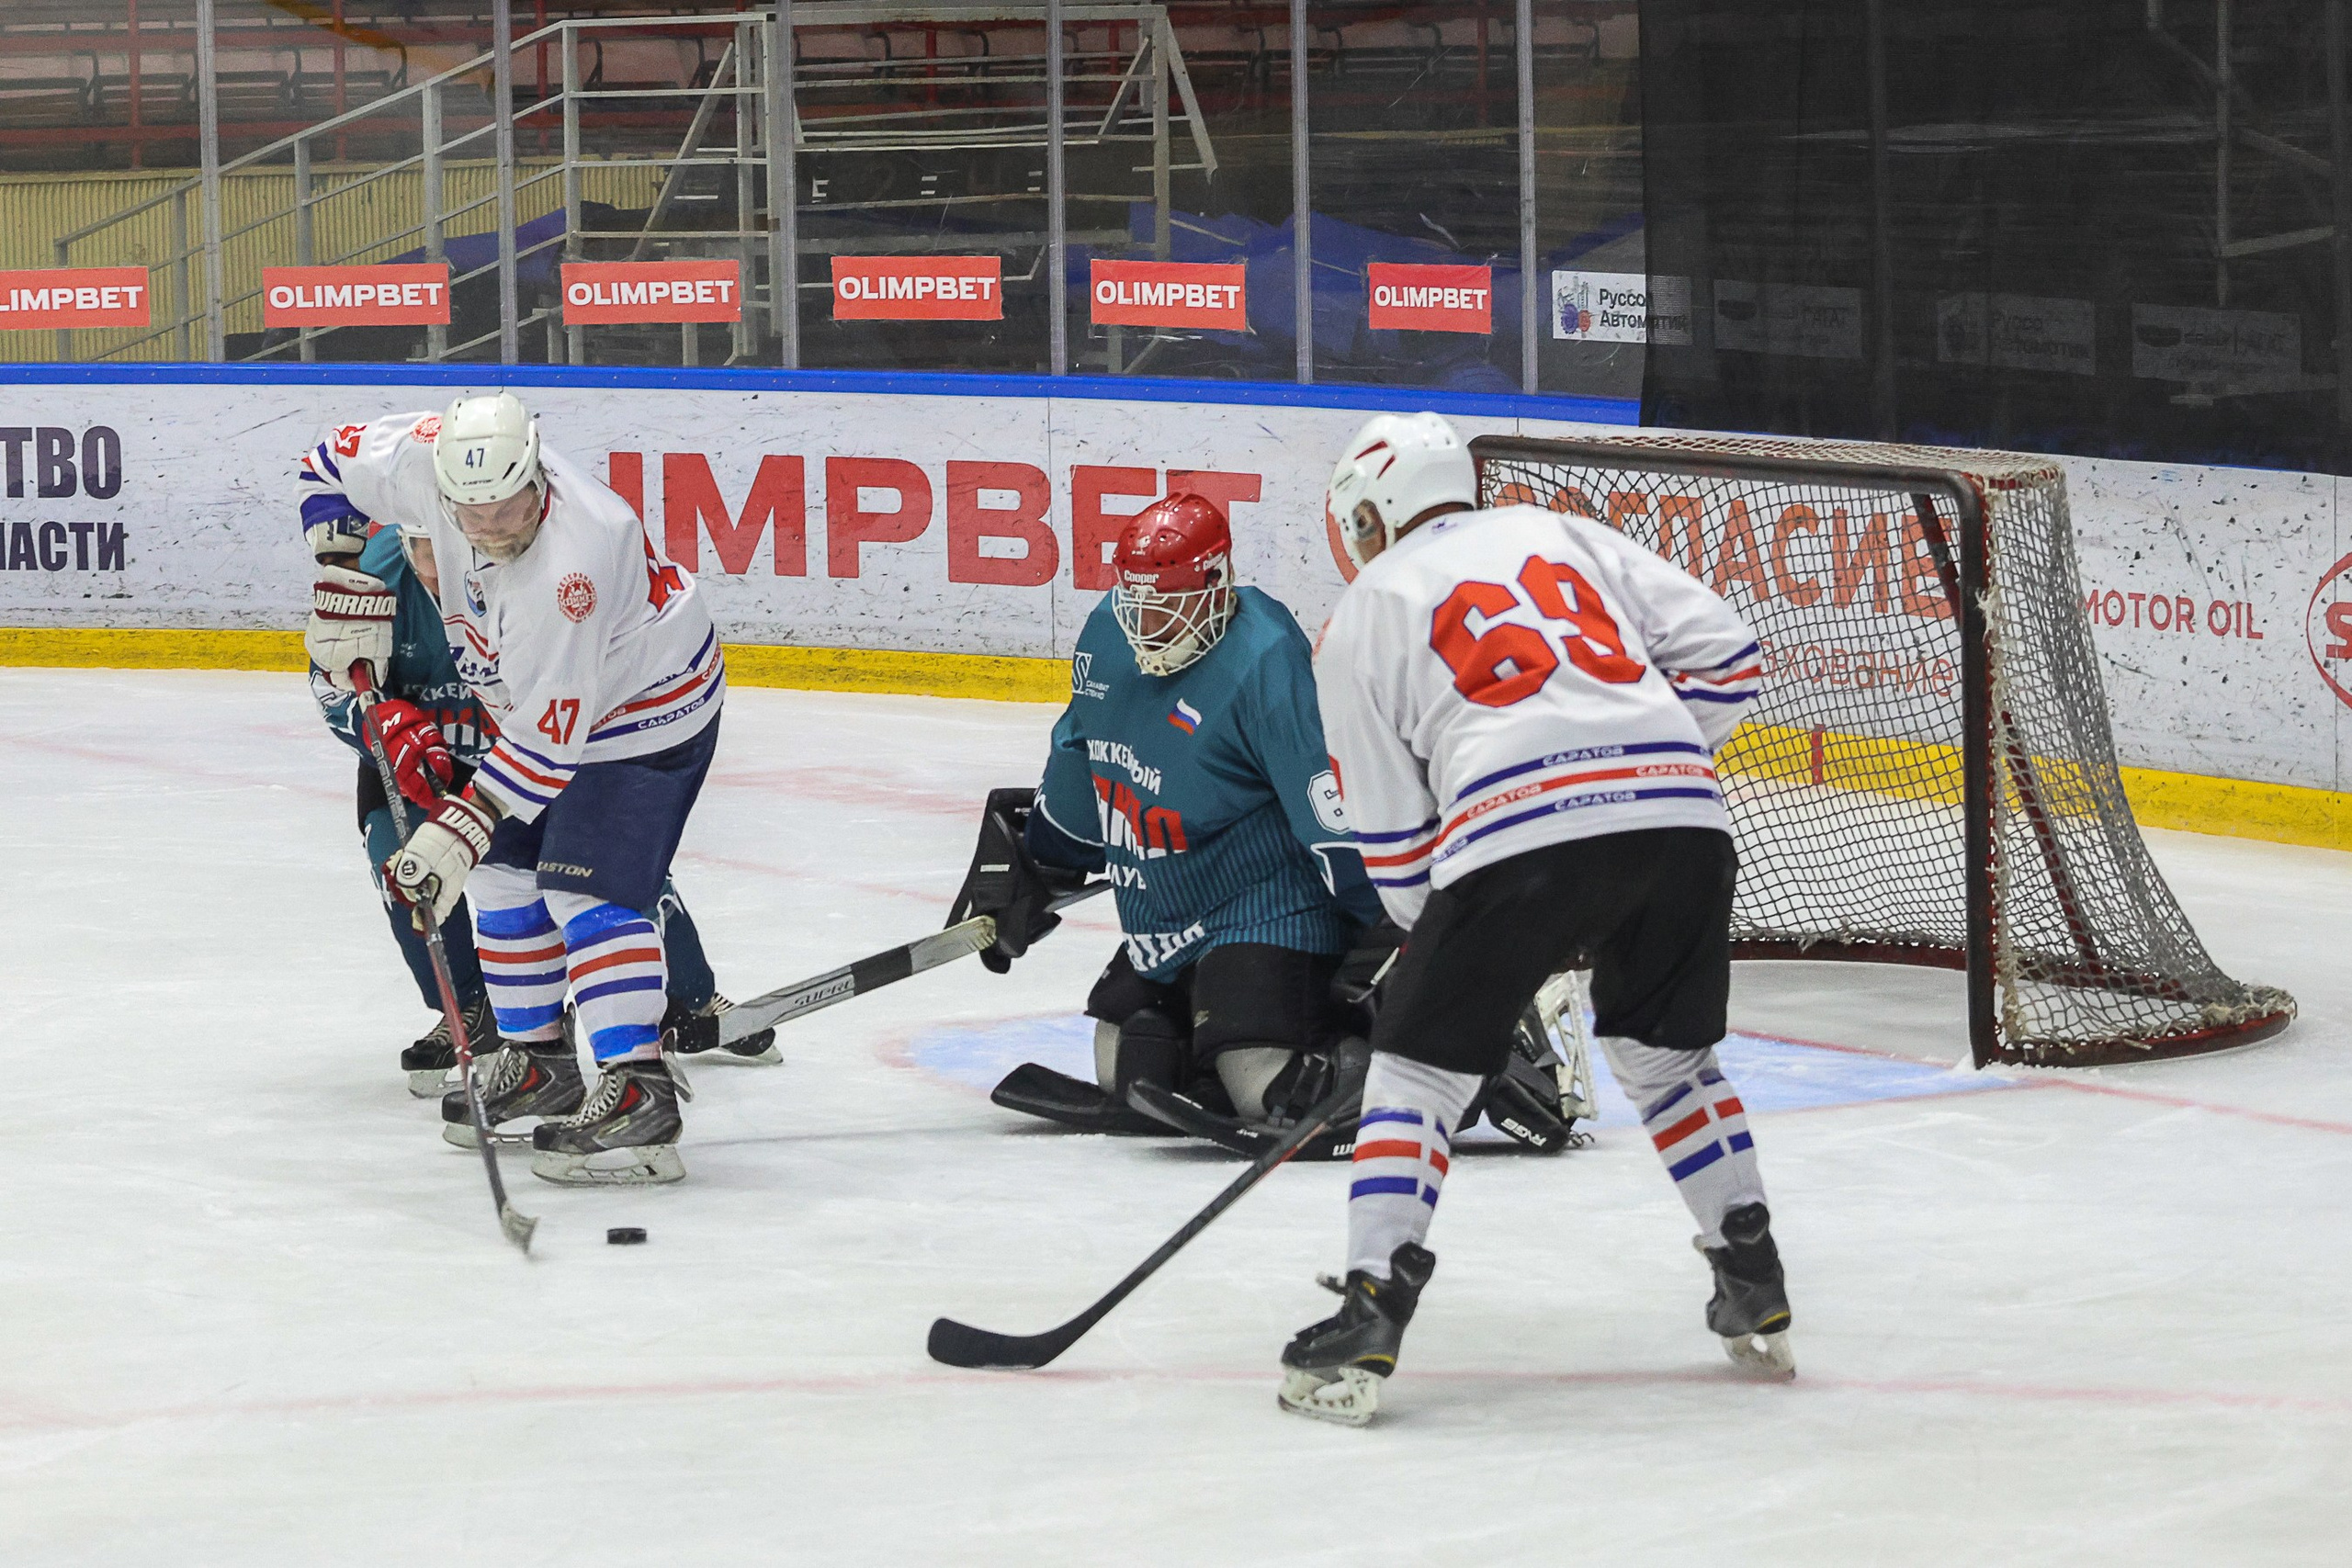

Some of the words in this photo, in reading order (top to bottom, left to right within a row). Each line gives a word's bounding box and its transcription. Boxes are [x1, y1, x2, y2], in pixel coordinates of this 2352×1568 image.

[269, 282, 443, 309] OLIMPBET
[567, 279, 734, 306] OLIMPBET
[838, 275, 996, 301] OLIMPBET
[1095, 279, 1240, 310] OLIMPBET
[1374, 285, 1487, 311] OLIMPBET
[1599, 288, 1646, 310] Руссо
[0, 425, 122, 500] ТВО
[466, 448, 484, 468] 47
[0, 521, 126, 571] АСТИ
[1124, 569, 1159, 585] Cooper
[2077, 589, 2195, 633] MOTOR
[2208, 600, 2264, 639] OIL
[1430, 554, 1646, 708] 69
[537, 698, 580, 745] 47
[638, 696, 706, 730] САРАТОВ
